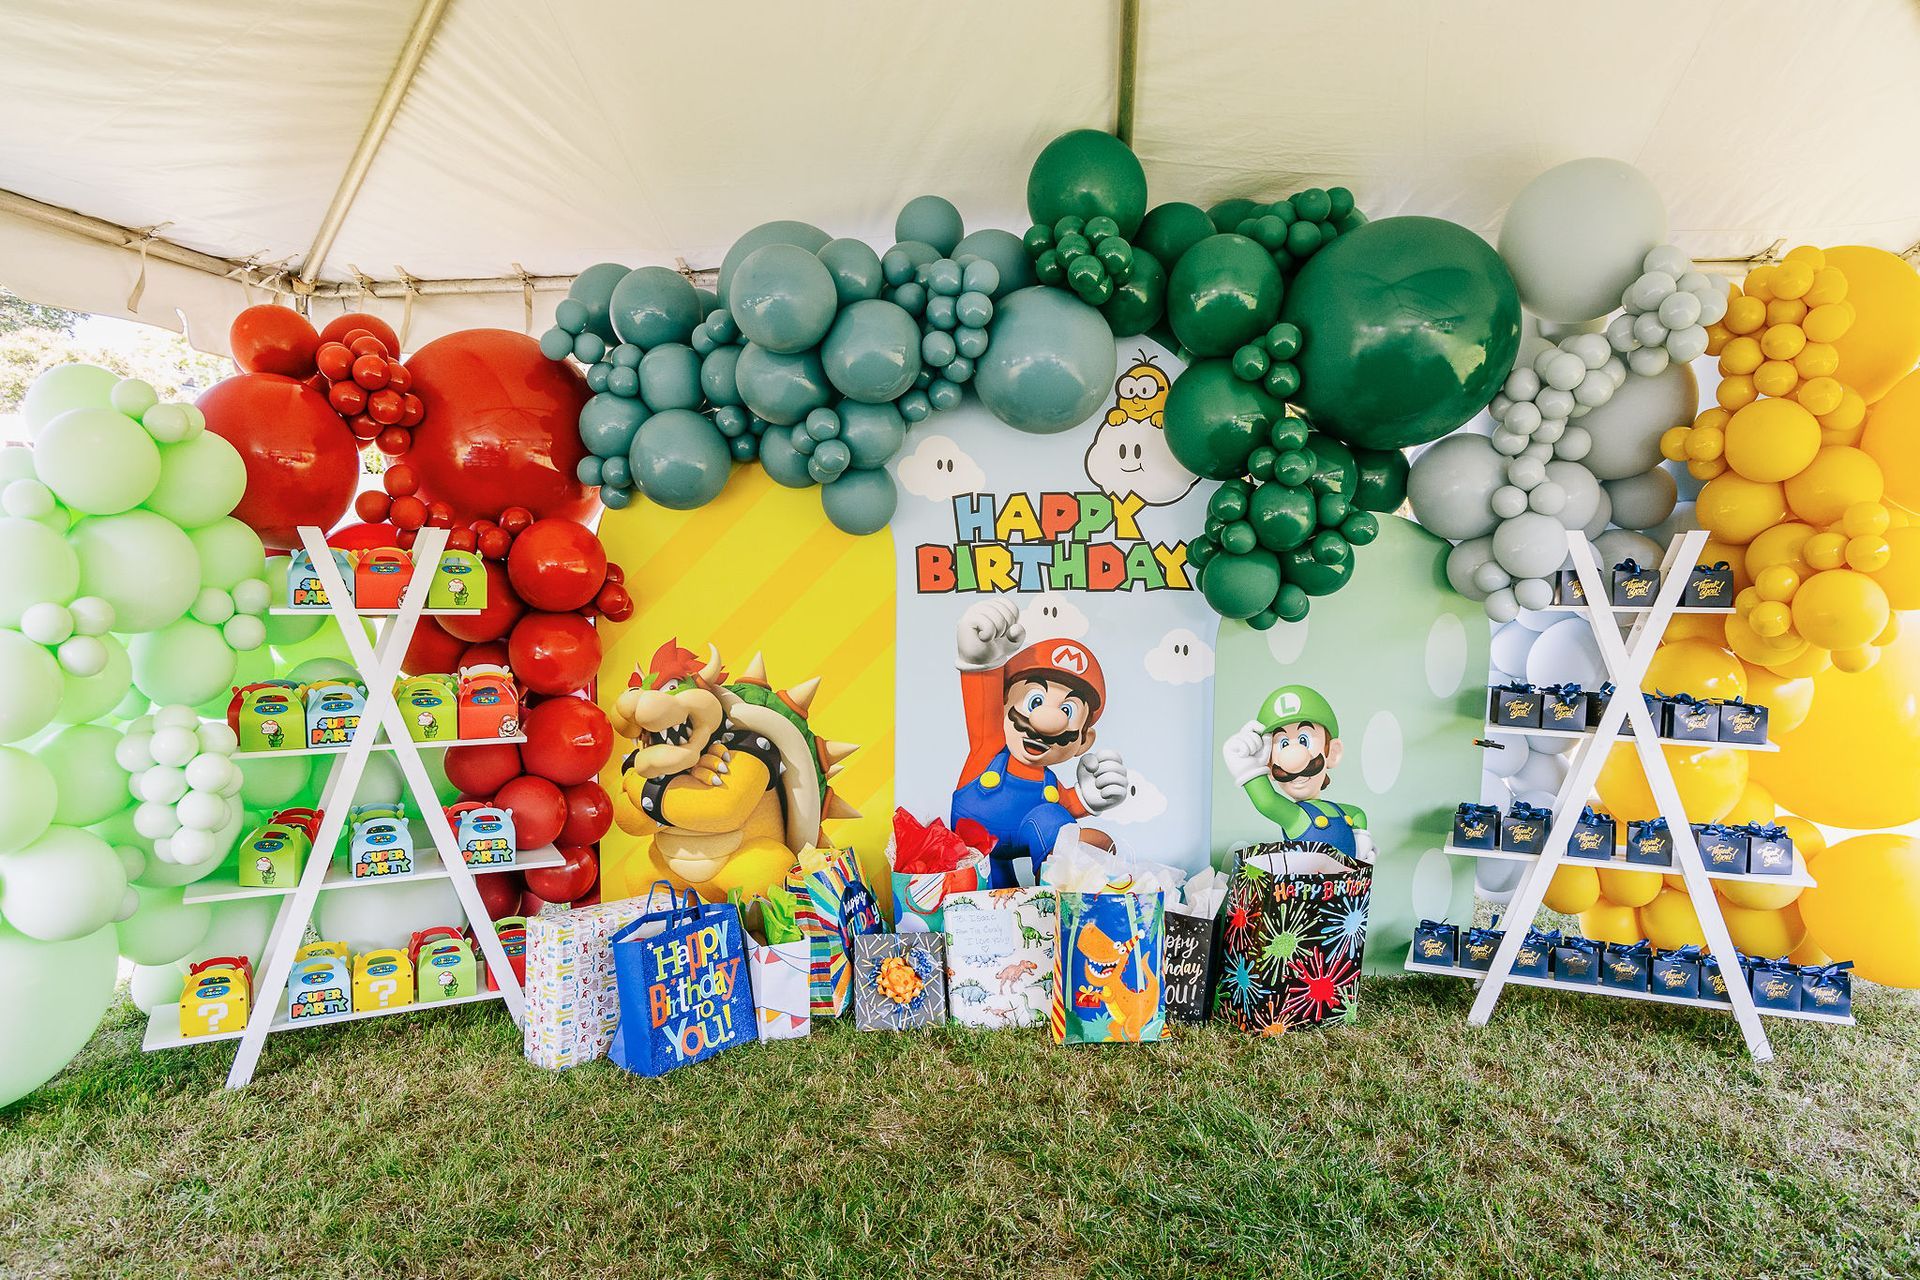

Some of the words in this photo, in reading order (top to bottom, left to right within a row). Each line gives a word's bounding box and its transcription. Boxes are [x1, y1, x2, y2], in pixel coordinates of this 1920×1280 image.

[952, 490, 1147, 543] HAPPY
[916, 540, 1194, 593] BIRTHDAY
[294, 589, 331, 605] PAR
[1054, 648, 1084, 672] M
[1280, 696, 1296, 714] L
[317, 716, 360, 729] SUPER
[362, 848, 406, 862] SUPER
[466, 838, 508, 851] SUPER
[462, 848, 513, 864] PARTY
[356, 857, 412, 878] PARTY
[1273, 881, 1322, 902] HAPPY
[1166, 934, 1198, 958] ppy
[296, 987, 342, 1004] SUPER
[649, 958, 741, 1028] Birthday
[291, 996, 349, 1022] PARTY
